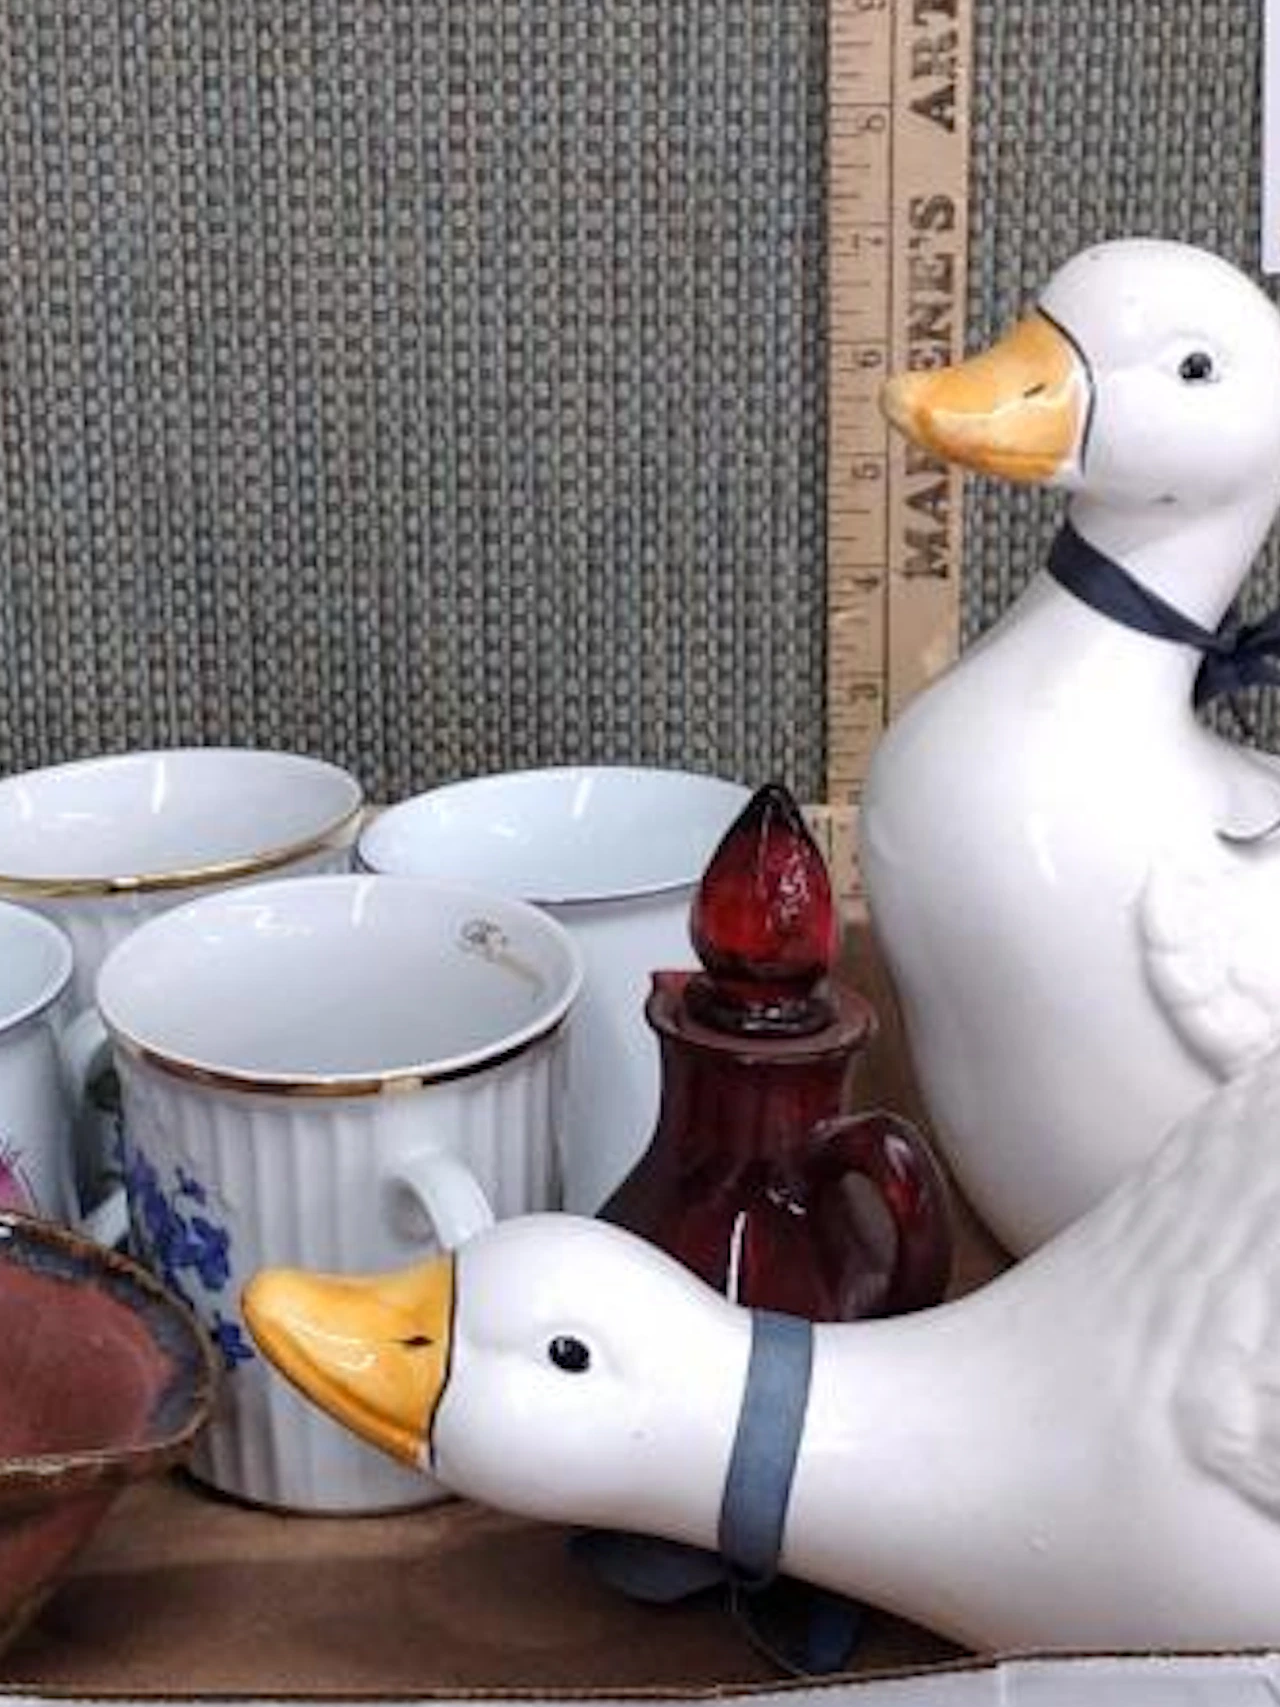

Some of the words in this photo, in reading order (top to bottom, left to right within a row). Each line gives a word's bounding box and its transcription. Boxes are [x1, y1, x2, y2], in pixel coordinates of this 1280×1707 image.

[854, 349, 883, 370] 6
[904, 195, 956, 579] MAENE'S
[852, 462, 881, 481] 5
